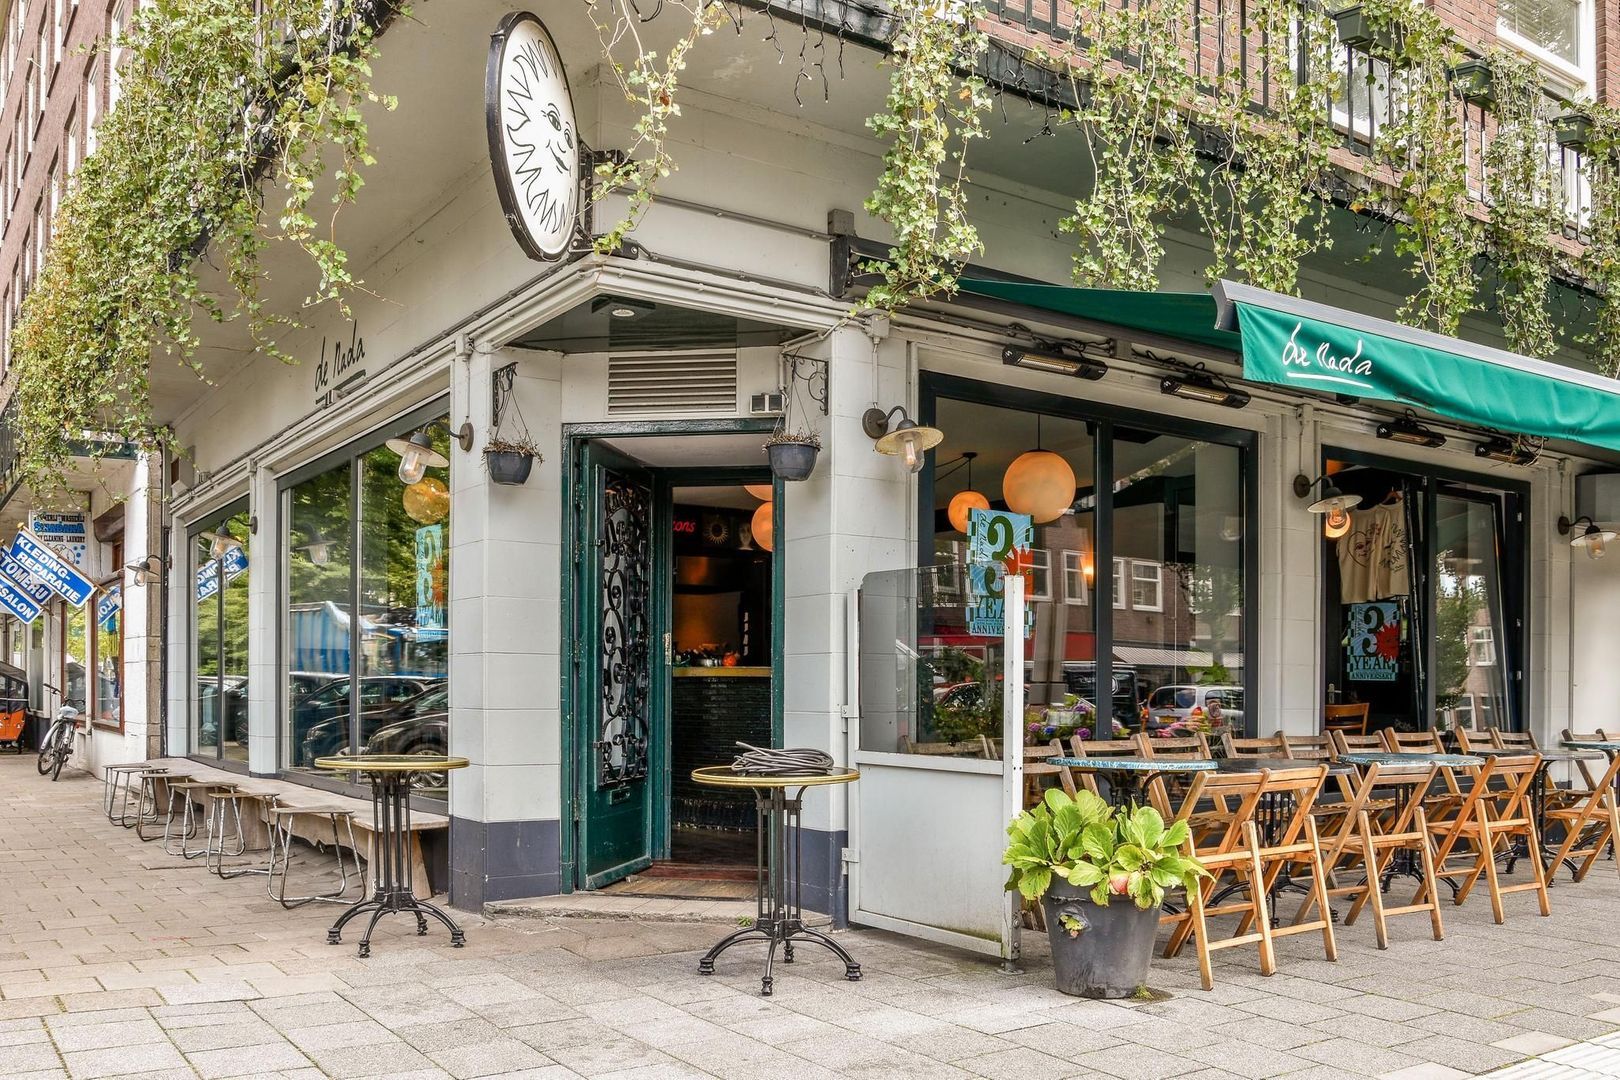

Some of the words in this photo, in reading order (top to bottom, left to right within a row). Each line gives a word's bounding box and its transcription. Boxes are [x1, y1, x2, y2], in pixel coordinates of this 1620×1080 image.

[44, 534, 63, 542] CLEANING
[16, 536, 71, 581] KLEDING-
[16, 552, 82, 603] REPARATIE
[0, 586, 35, 619] SALON
[973, 595, 1005, 619] YE
[971, 624, 1005, 635] ANNIVE
[1361, 606, 1385, 657] 3
[1352, 656, 1392, 670] YEAR
